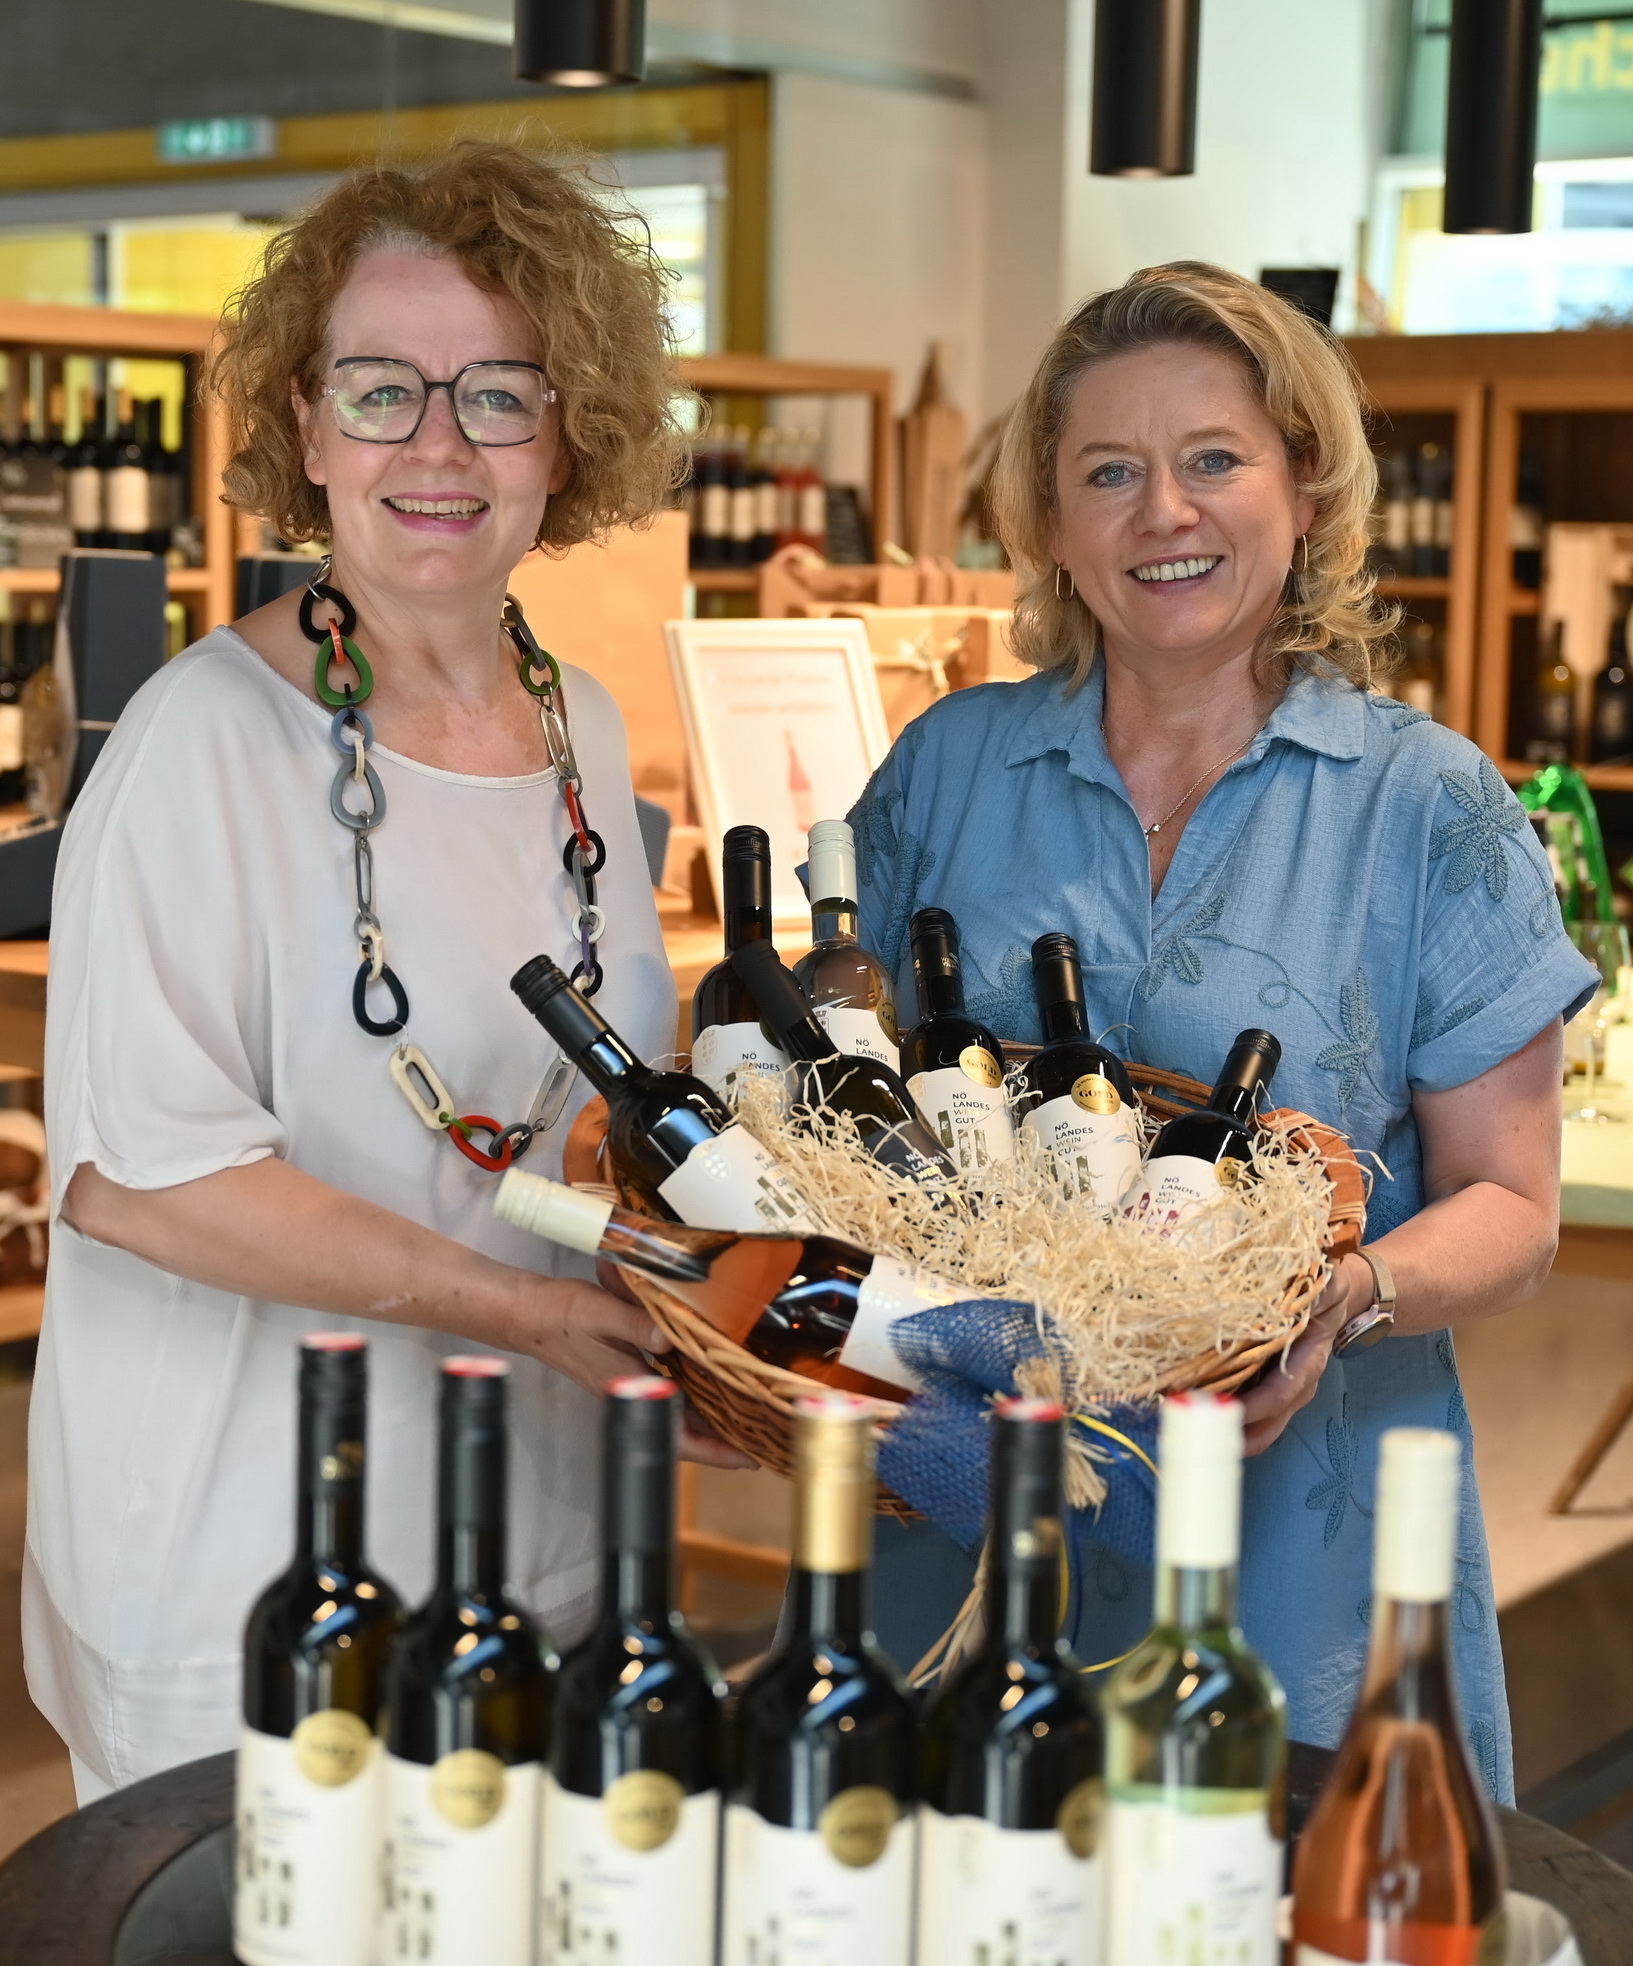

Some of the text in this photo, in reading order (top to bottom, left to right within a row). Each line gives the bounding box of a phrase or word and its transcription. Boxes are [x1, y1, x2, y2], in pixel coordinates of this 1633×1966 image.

[855, 1038, 870, 1047] NÖ
[742, 1051, 757, 1060] NÖ
[856, 1048, 889, 1062] LANDES
[952, 1091, 967, 1100] NÖ
[953, 1101, 990, 1111] LANDES
[1054, 1121, 1069, 1132] NÖ
[1055, 1127, 1094, 1140] LANDES
[1056, 1136, 1081, 1148] WEIN
[1160, 1184, 1200, 1198] LANDES
